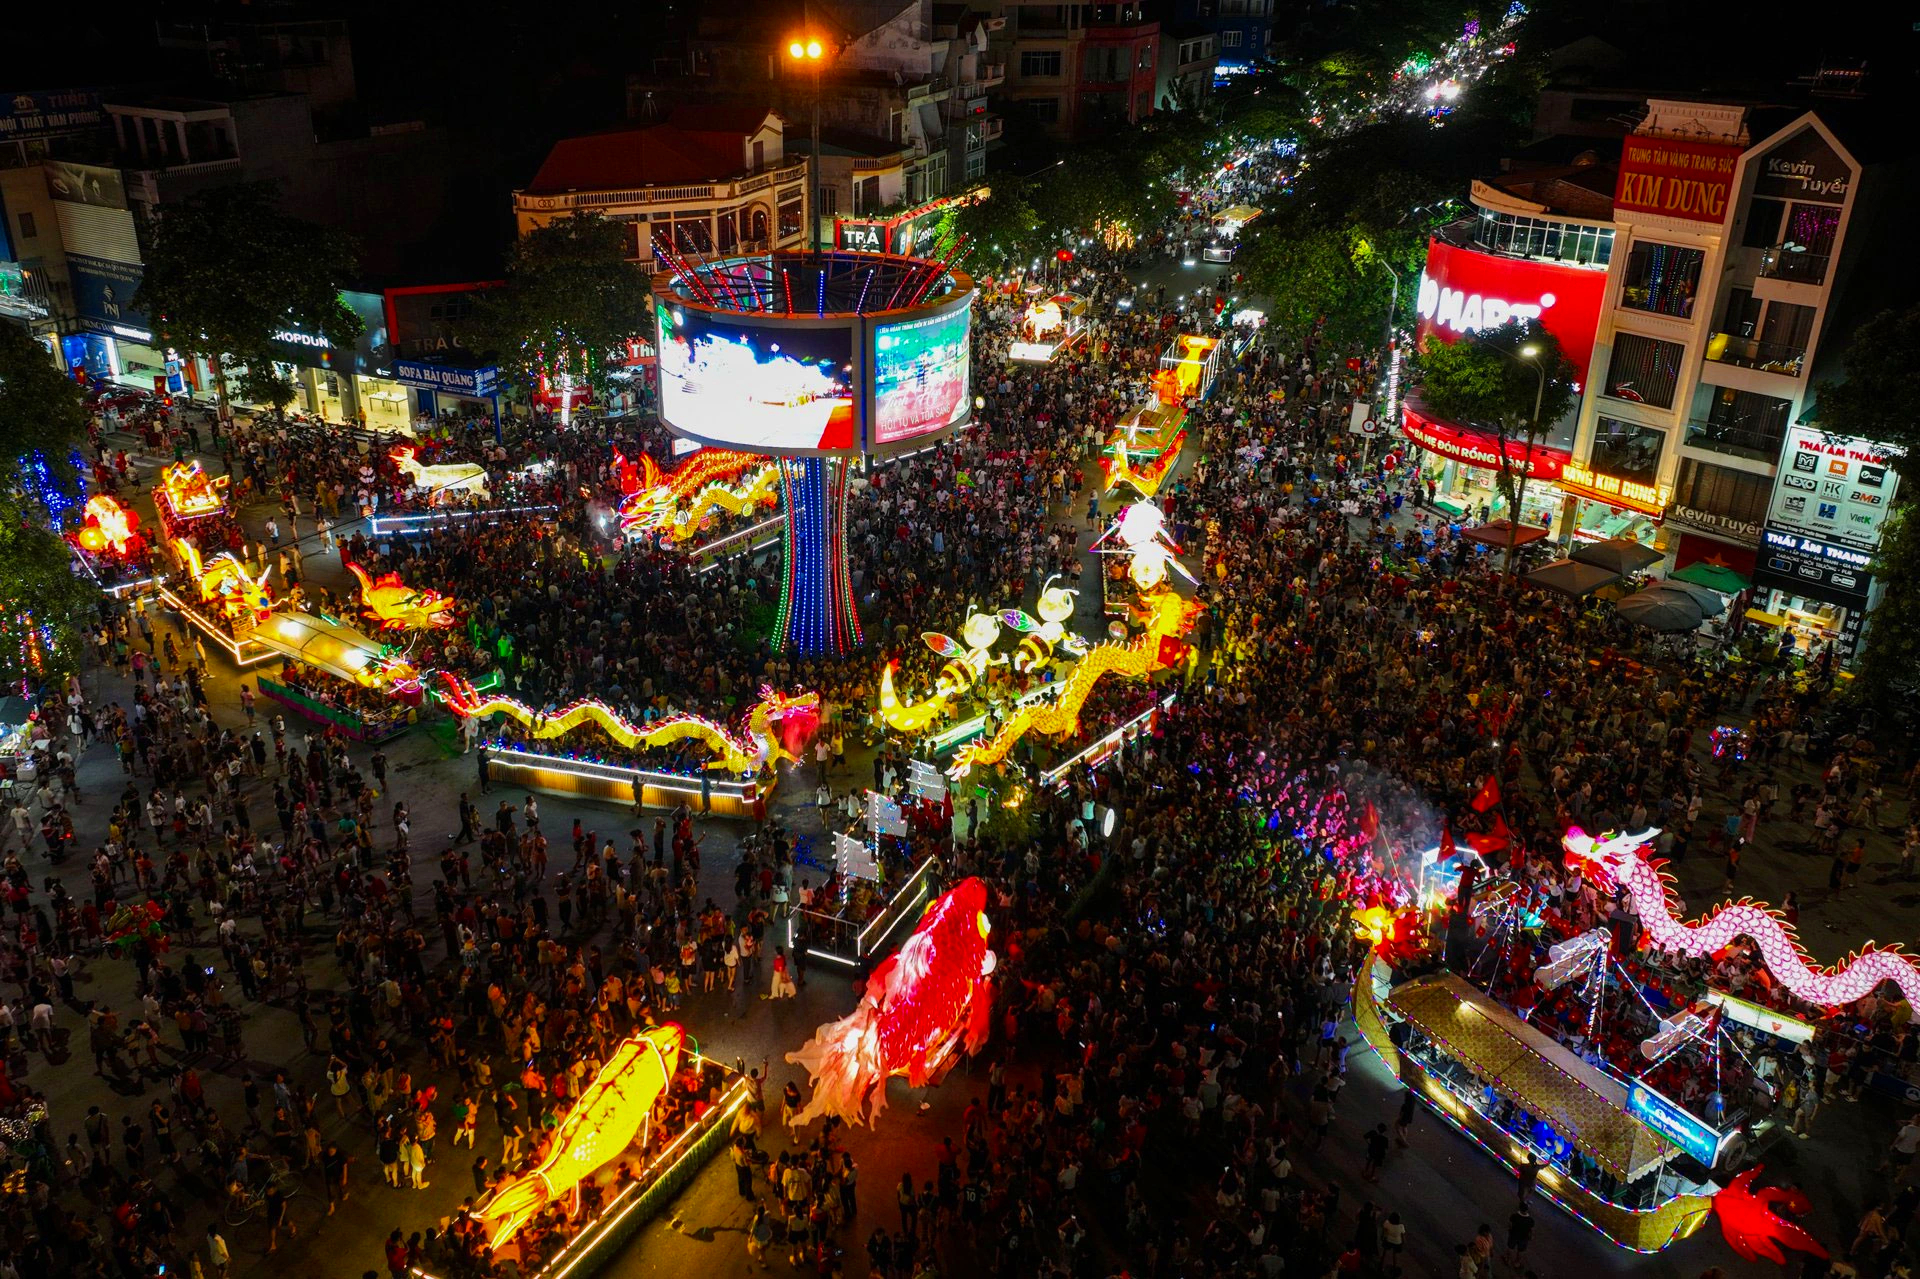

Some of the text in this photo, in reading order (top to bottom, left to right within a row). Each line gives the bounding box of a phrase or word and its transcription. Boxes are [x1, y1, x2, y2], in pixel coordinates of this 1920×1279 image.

[1628, 146, 1734, 174] TRUNG TÂM VÀNG TRANG SỨC
[1768, 157, 1815, 176] Kevin
[1619, 171, 1726, 217] KIM DUNG
[398, 365, 423, 379] SOFA
[1413, 427, 1424, 442] BA
[1423, 434, 1437, 449] MẸ
[1437, 438, 1460, 456] ĐÓN
[1460, 445, 1497, 464] RỒNG
[1595, 473, 1621, 494] KIM
[1621, 480, 1657, 504] DUNG
[1785, 476, 1816, 490] NEXO
[1824, 482, 1842, 496] HK
[1850, 491, 1882, 505] BMB
[1675, 504, 1716, 525] Kevin
[1767, 532, 1796, 548] THÁI
[966, 1190, 977, 1203] 10
